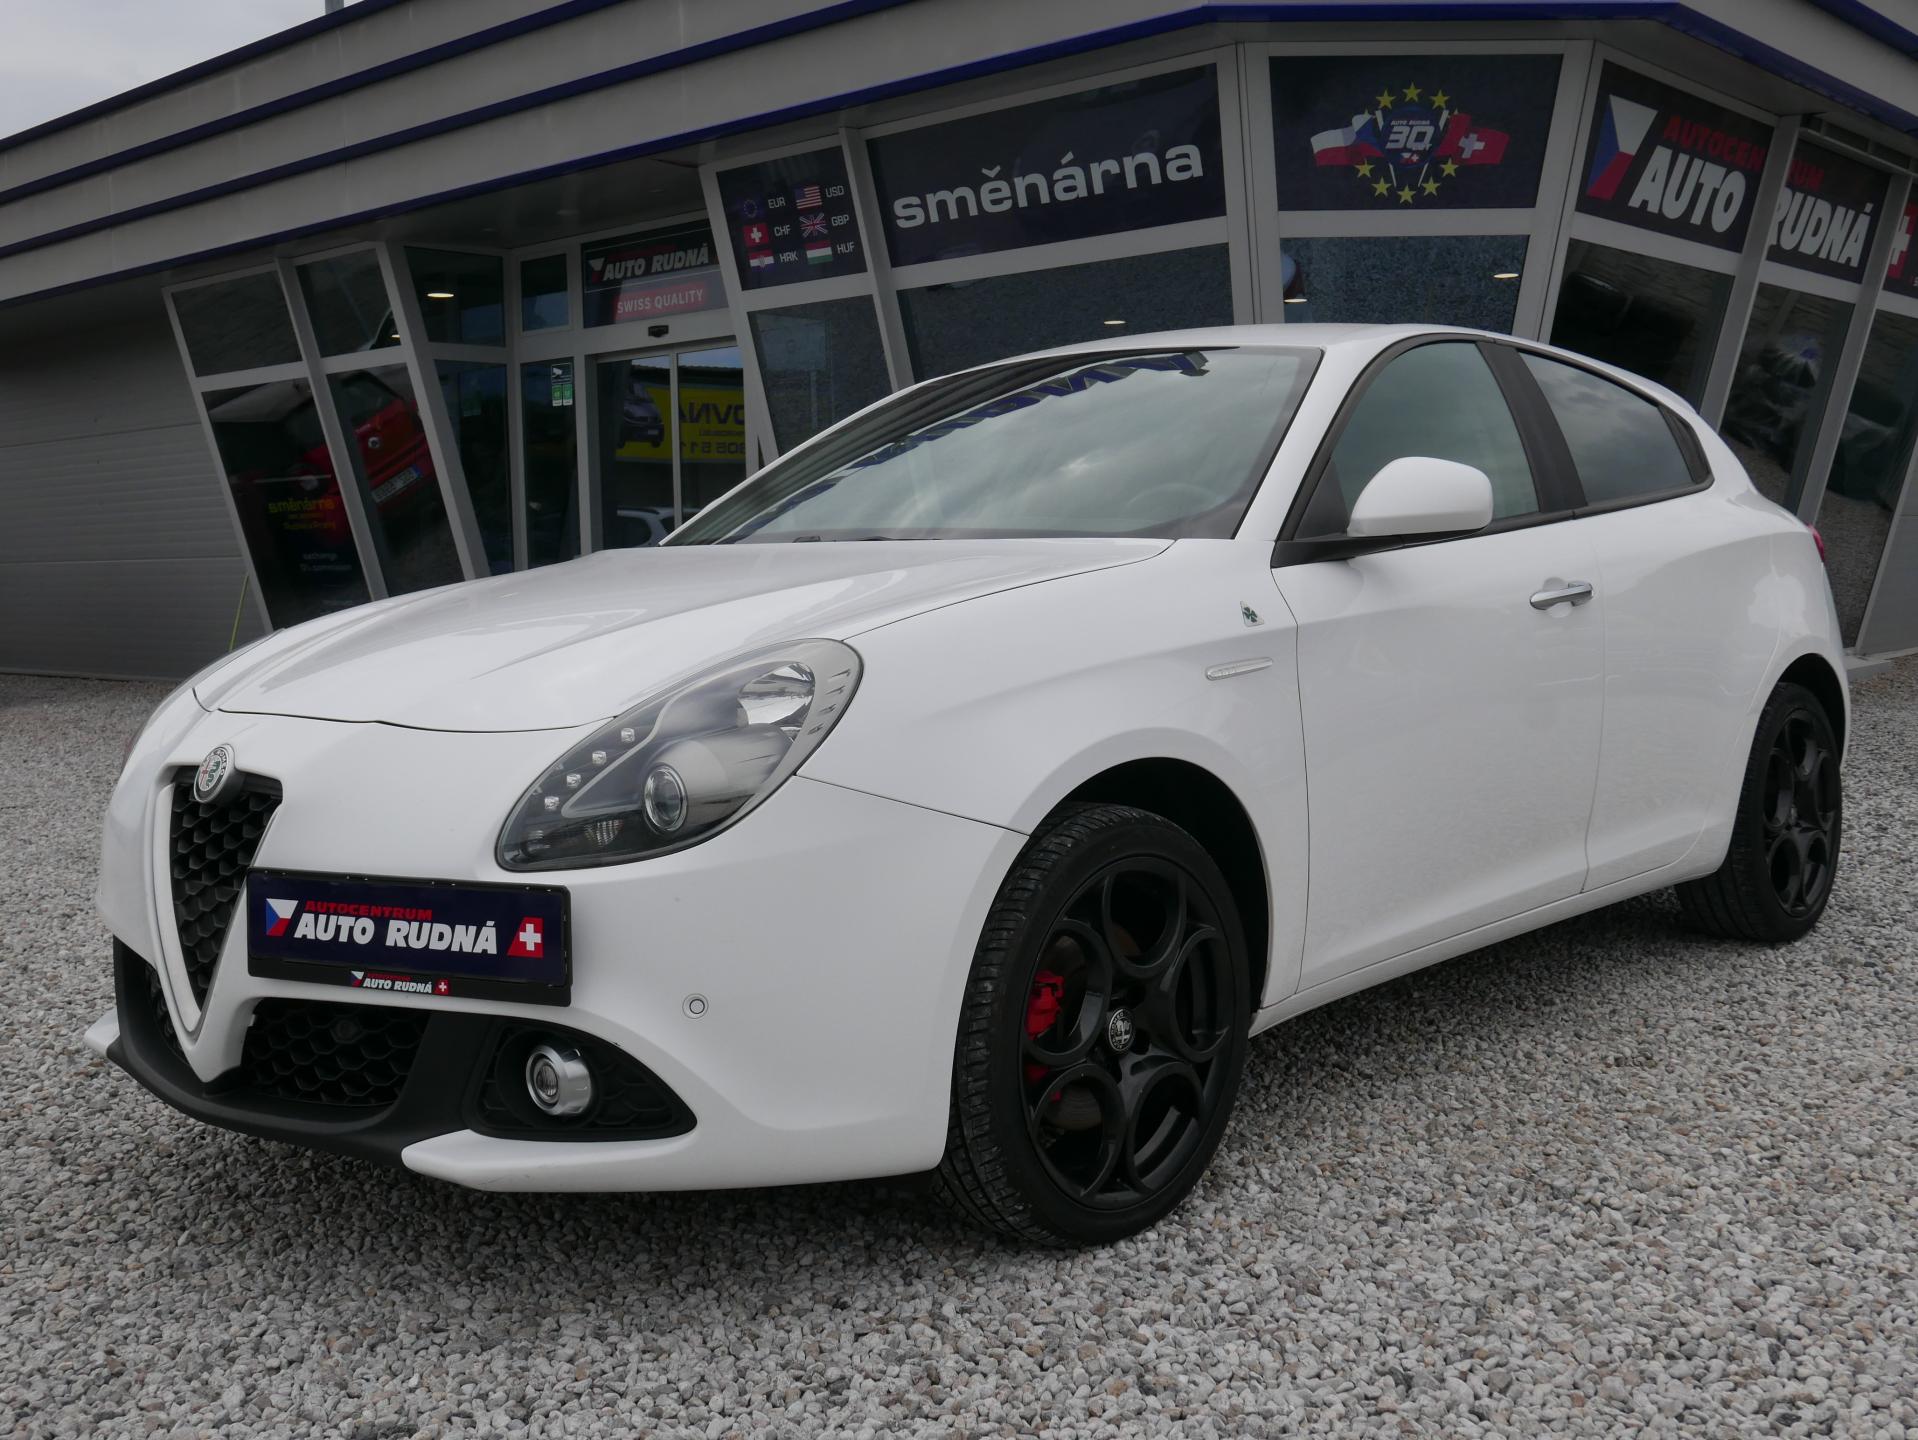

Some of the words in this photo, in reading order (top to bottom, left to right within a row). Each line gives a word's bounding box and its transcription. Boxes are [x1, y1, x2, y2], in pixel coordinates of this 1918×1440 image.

[1385, 125, 1435, 150] 30
[825, 185, 845, 198] USD
[893, 144, 1204, 229] směnárna
[1628, 145, 1746, 233] AUTO
[768, 197, 786, 209] EUR
[831, 214, 850, 227] GBP
[774, 224, 792, 237] CHF
[836, 241, 856, 254] HUF
[603, 258, 646, 280] AUTO
[651, 243, 709, 273] RUDNÁ
[780, 251, 799, 263] HRK
[617, 297, 651, 314] SWISS
[654, 289, 703, 309] QUALITY
[303, 900, 433, 920] AUTOCENTRUM
[294, 913, 376, 945] AUTO
[385, 920, 498, 955] RUDNÁ
[363, 977, 391, 991] AUTO
[394, 980, 433, 994] RUDNÁ
